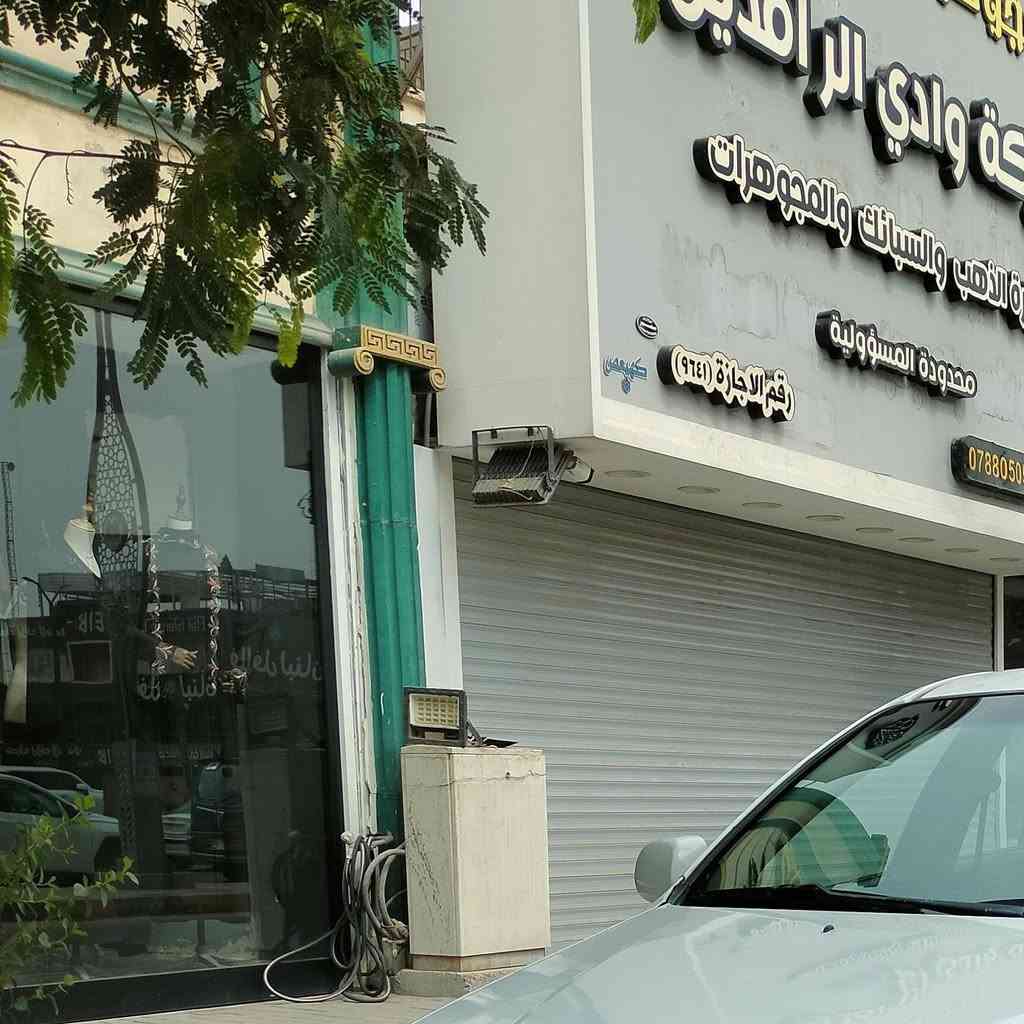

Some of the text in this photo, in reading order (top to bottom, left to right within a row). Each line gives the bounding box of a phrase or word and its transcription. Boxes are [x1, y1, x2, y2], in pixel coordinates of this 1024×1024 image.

[878, 68, 966, 183] وادي
[707, 135, 852, 246] والمجوهرات
[858, 204, 948, 292] والسبائك
[954, 258, 1008, 310] الذهب
[765, 370, 794, 419] رقم
[830, 314, 976, 395] محدودة المسؤولية
